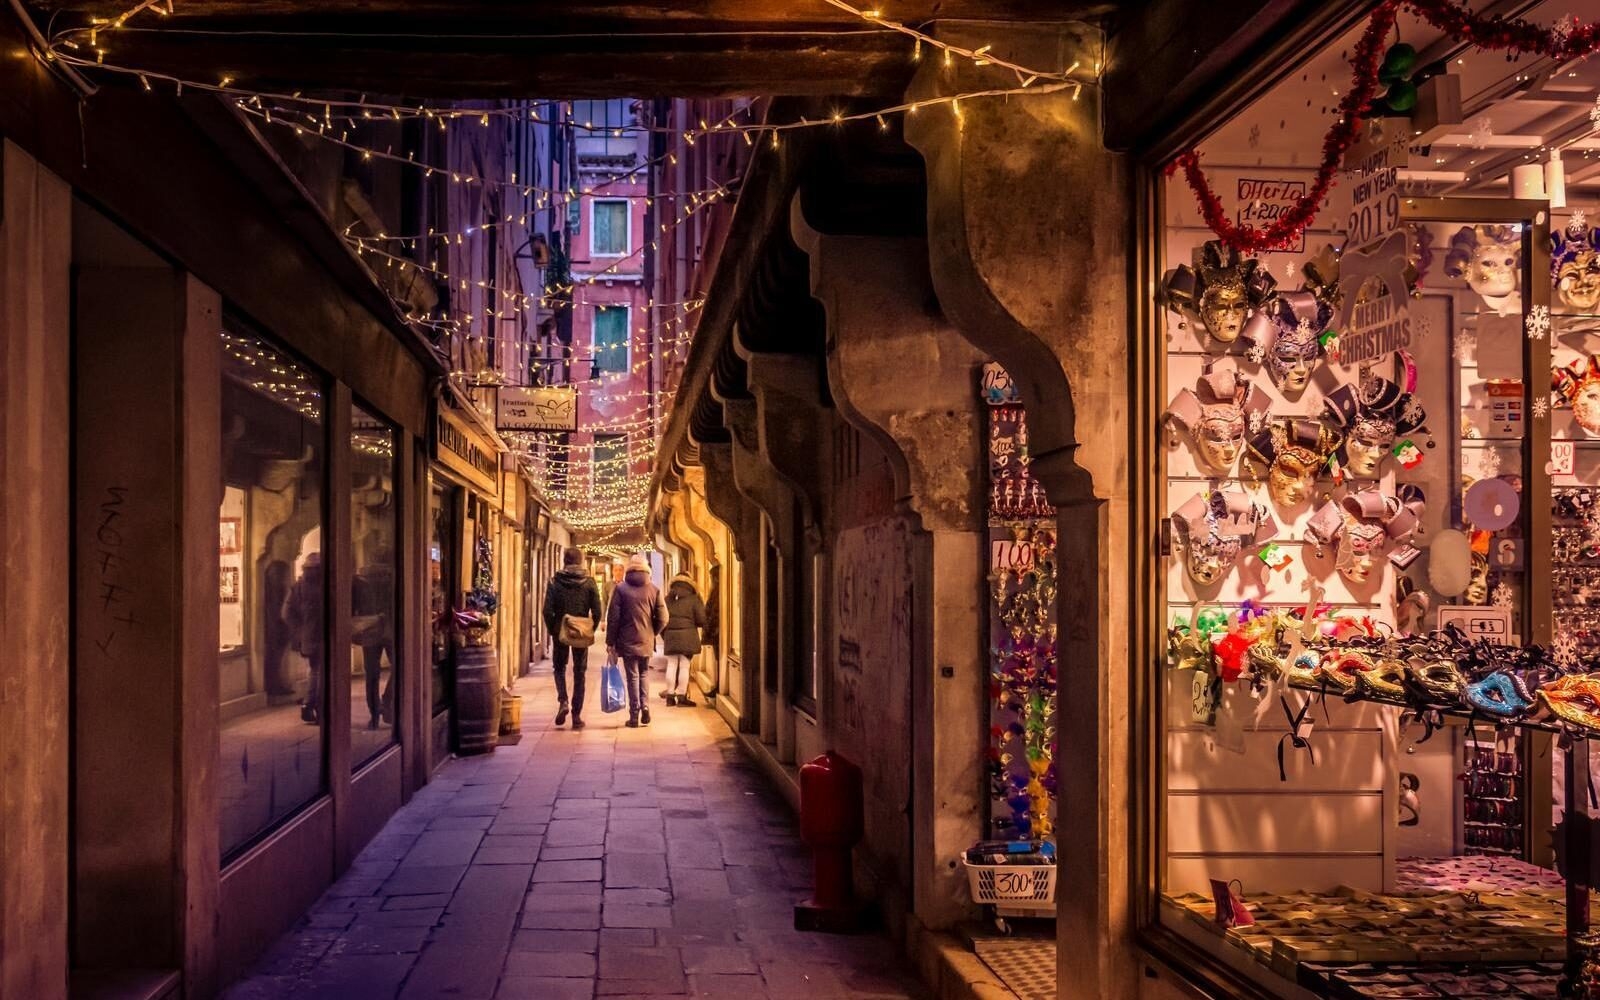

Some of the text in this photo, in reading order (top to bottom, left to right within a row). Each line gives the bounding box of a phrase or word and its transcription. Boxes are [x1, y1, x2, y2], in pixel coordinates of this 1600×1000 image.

[1361, 147, 1390, 178] HAPPY
[1353, 168, 1397, 206] NEW YEAR
[1348, 192, 1400, 245] 2019
[1356, 296, 1392, 330] MERRY
[1339, 318, 1410, 367] CHRISTMAS
